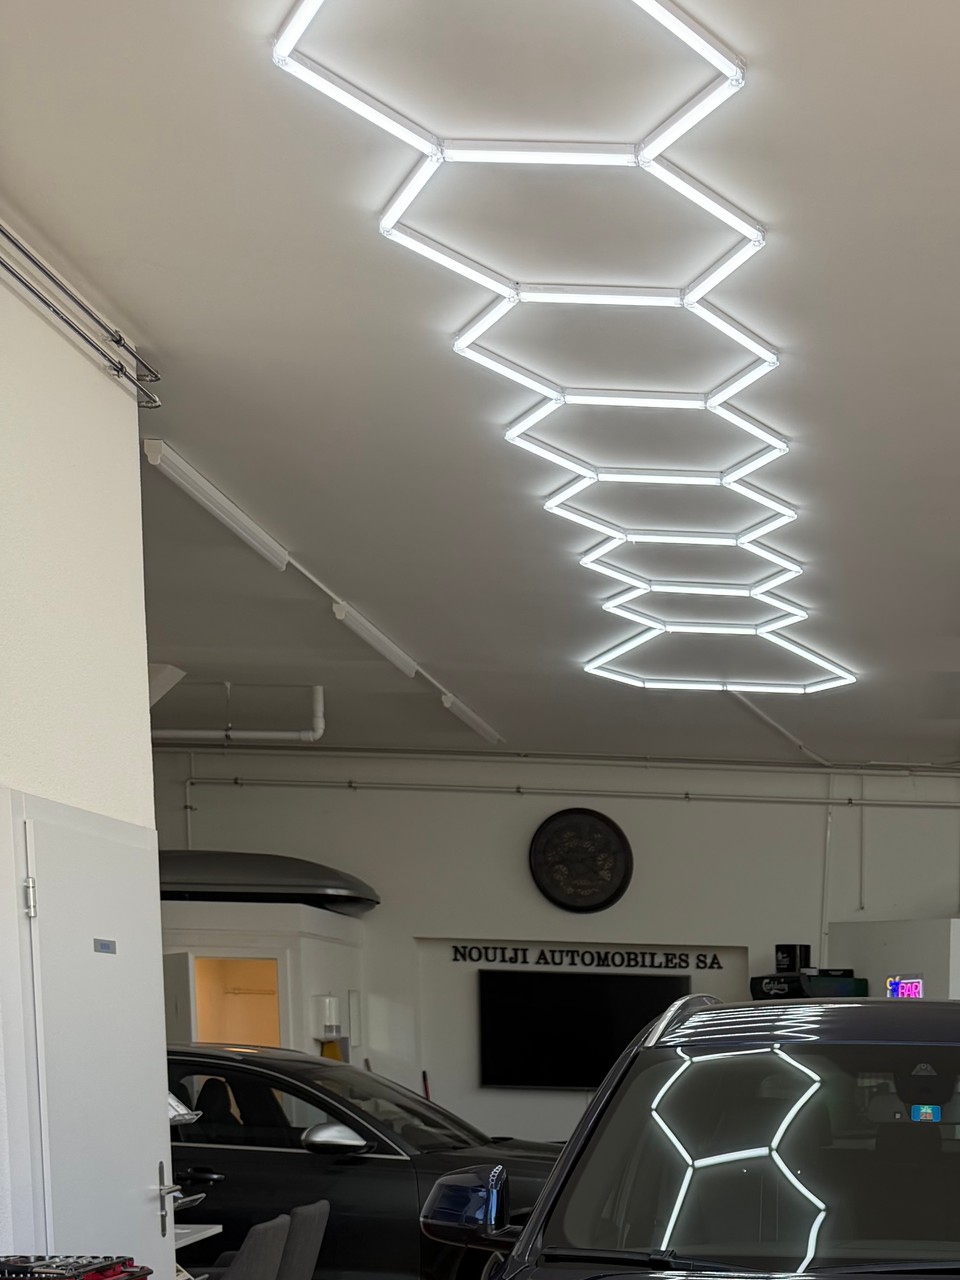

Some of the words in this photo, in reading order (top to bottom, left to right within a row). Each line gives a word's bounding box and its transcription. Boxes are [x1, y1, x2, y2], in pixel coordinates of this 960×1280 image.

[452, 945, 529, 964] NOUIJI
[535, 949, 690, 969] AUTOMOBILES
[696, 953, 723, 970] SA
[898, 983, 919, 998] BAR
